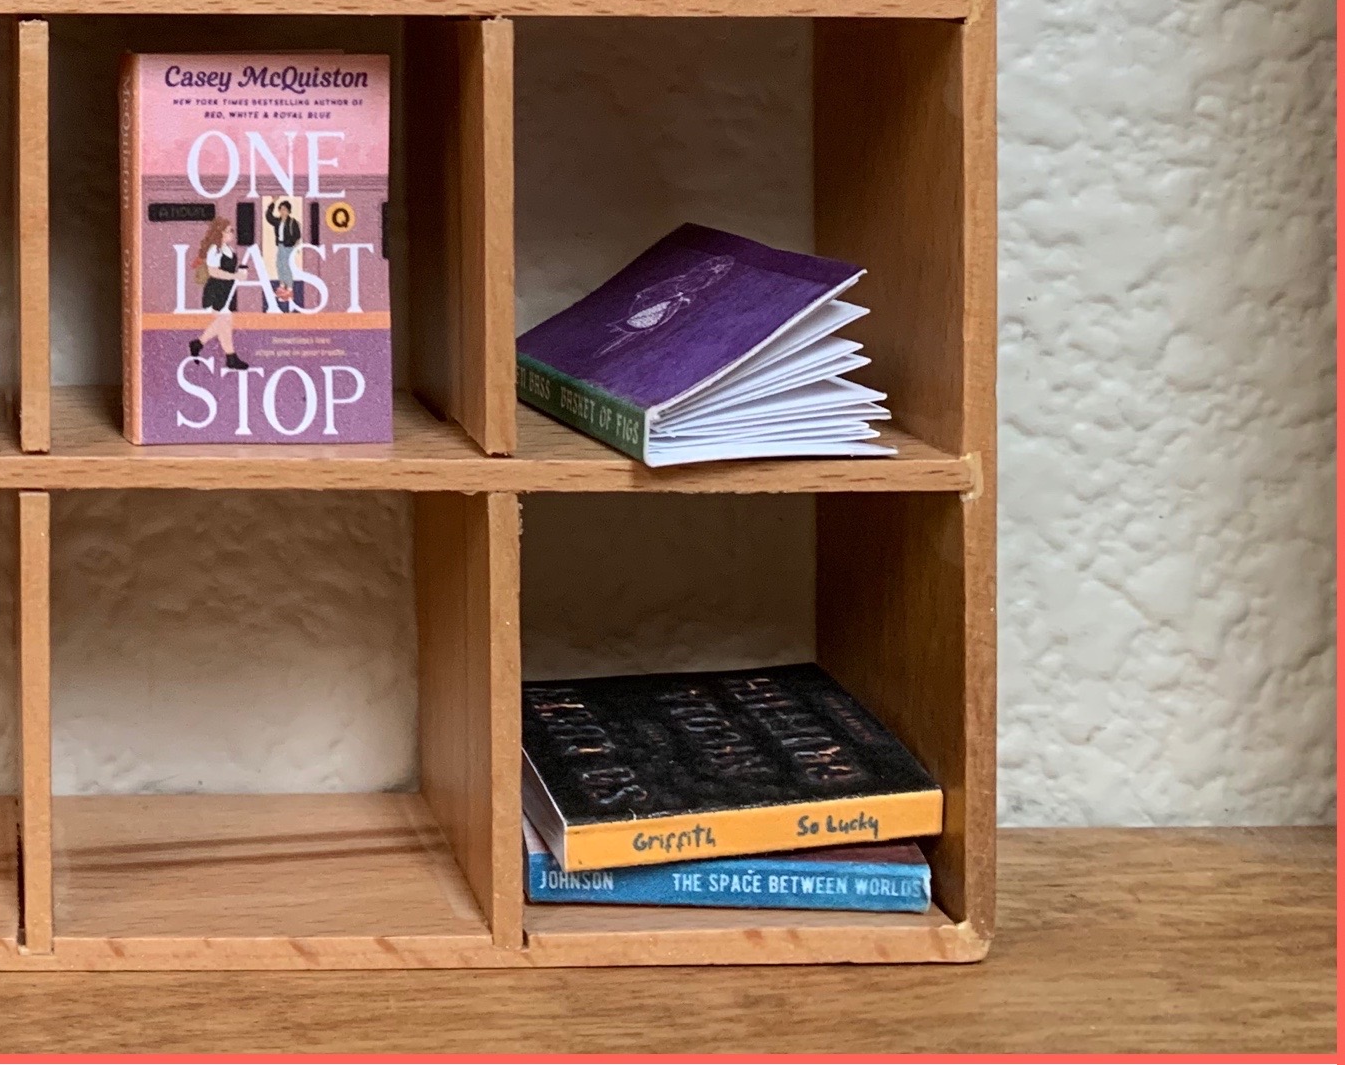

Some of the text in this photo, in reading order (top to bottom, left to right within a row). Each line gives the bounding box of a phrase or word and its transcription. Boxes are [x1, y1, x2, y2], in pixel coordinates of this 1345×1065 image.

[165, 65, 369, 94] Casey McQuiston
[187, 130, 346, 199] ONE
[332, 207, 351, 229] Q
[172, 243, 375, 315] LAST
[176, 356, 366, 436] STOP
[598, 405, 613, 431] OF
[615, 413, 640, 445] FIGS
[633, 812, 879, 853] Griffith So Lucky
[539, 870, 924, 897] JOHNSON THE SPACE BETWEEN WORLDS
